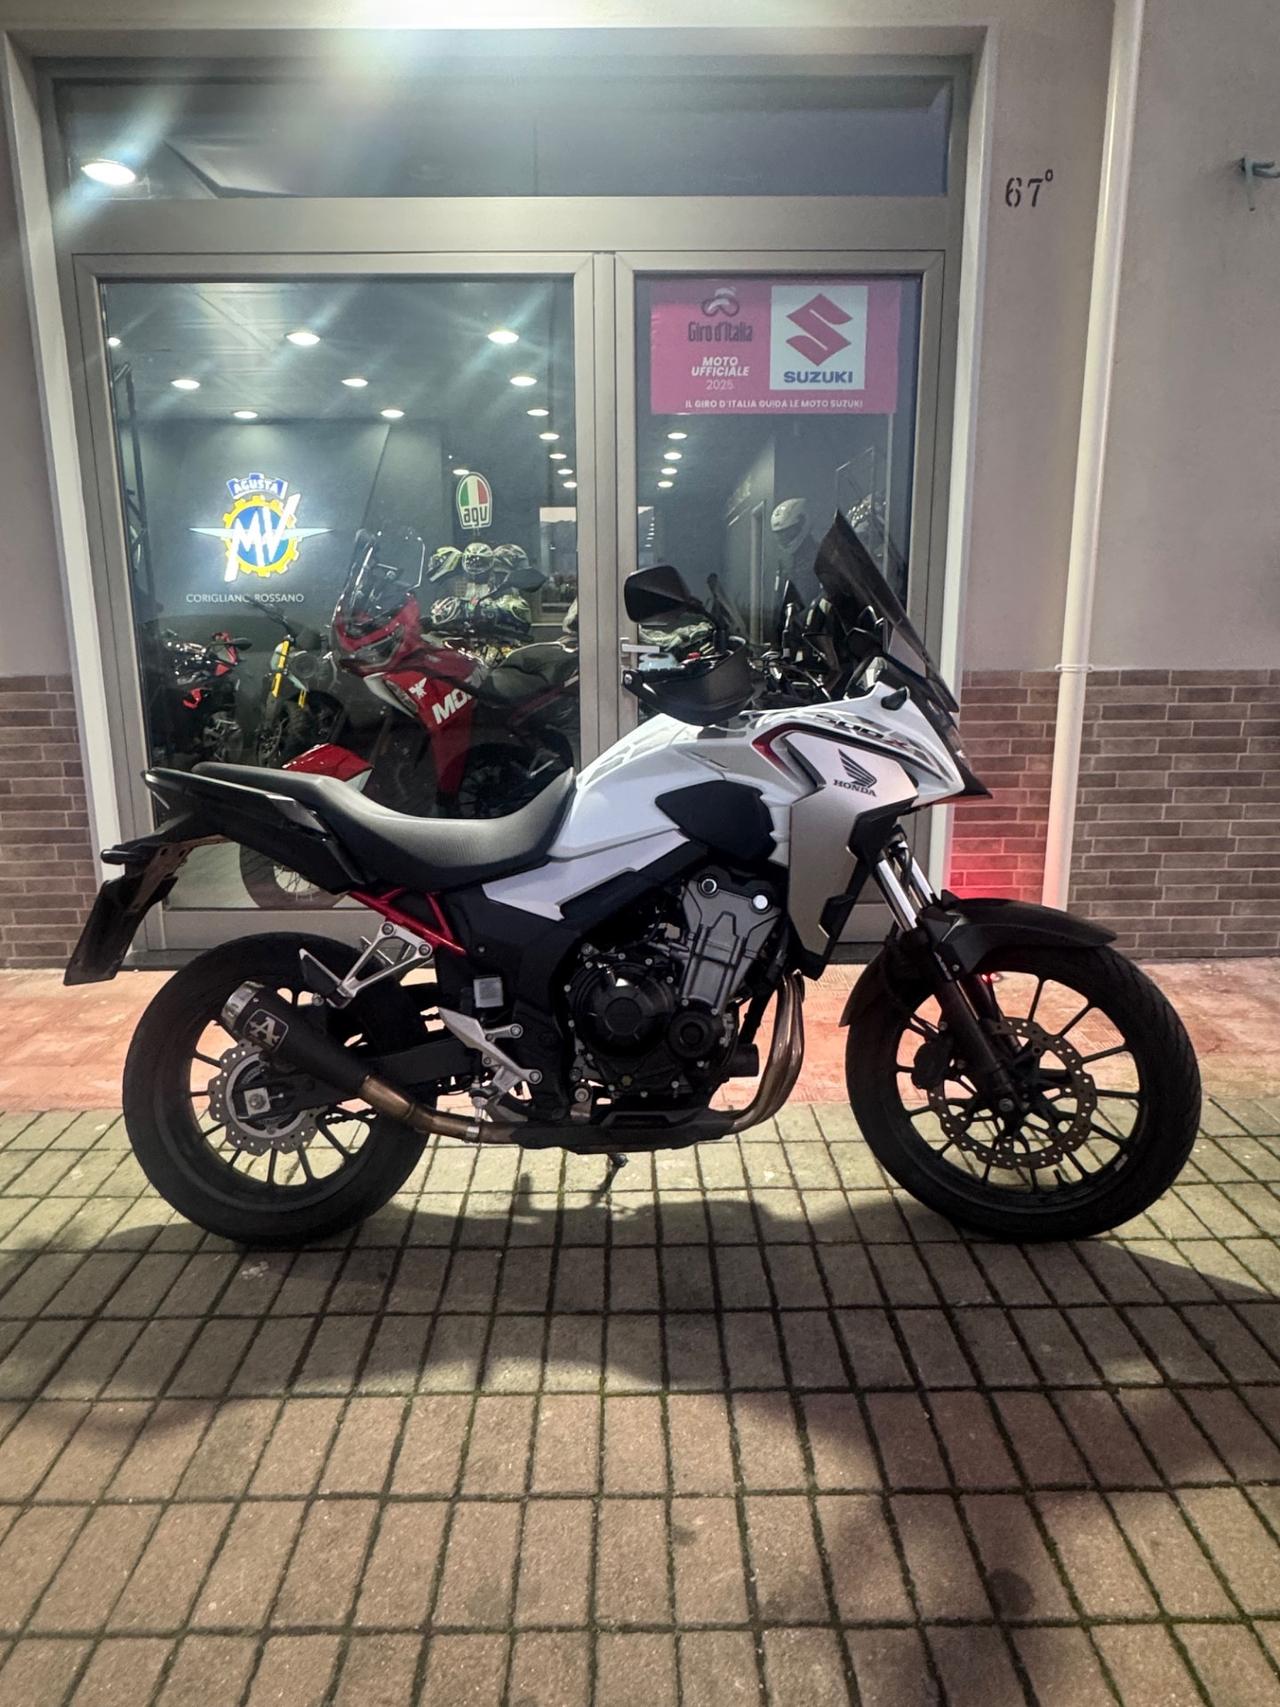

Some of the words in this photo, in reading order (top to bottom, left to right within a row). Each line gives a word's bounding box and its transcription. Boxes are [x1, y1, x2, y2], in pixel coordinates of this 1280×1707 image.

[688, 321, 712, 342] Giro
[714, 321, 753, 342] d'Italia
[702, 356, 739, 367] MOTO
[691, 366, 750, 377] UFFICIALE
[784, 371, 853, 384] SUZUKI
[695, 400, 718, 408] GIRO
[759, 400, 787, 408] GUIDA
[789, 400, 800, 408] LE
[801, 400, 829, 408] MOTO
[830, 400, 864, 408] SUZUKI
[233, 479, 279, 494] AGUSTA
[224, 494, 301, 582] MV
[833, 779, 877, 797] HONDA
